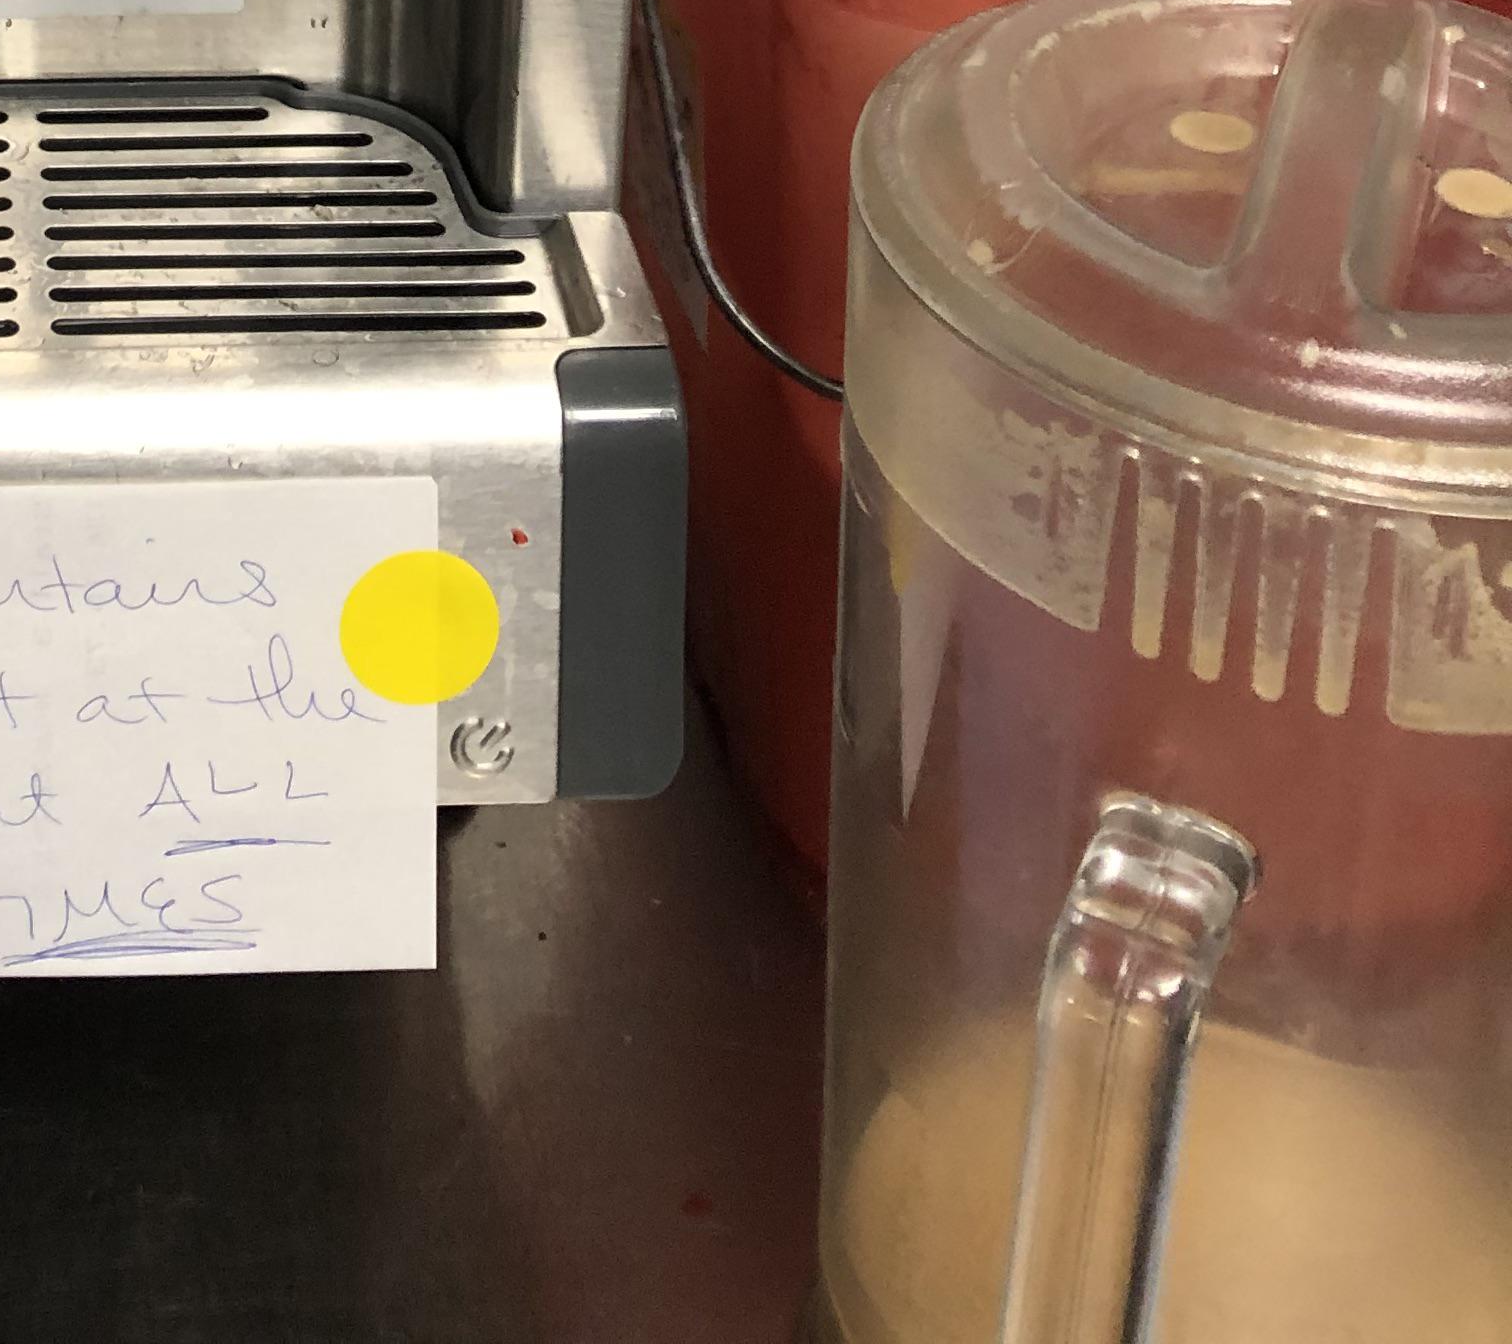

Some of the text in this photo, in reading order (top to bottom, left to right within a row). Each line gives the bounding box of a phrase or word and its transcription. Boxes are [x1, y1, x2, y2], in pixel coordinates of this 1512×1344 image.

[76, 677, 186, 723] at
[207, 633, 387, 722] the
[138, 760, 329, 825] ALL
